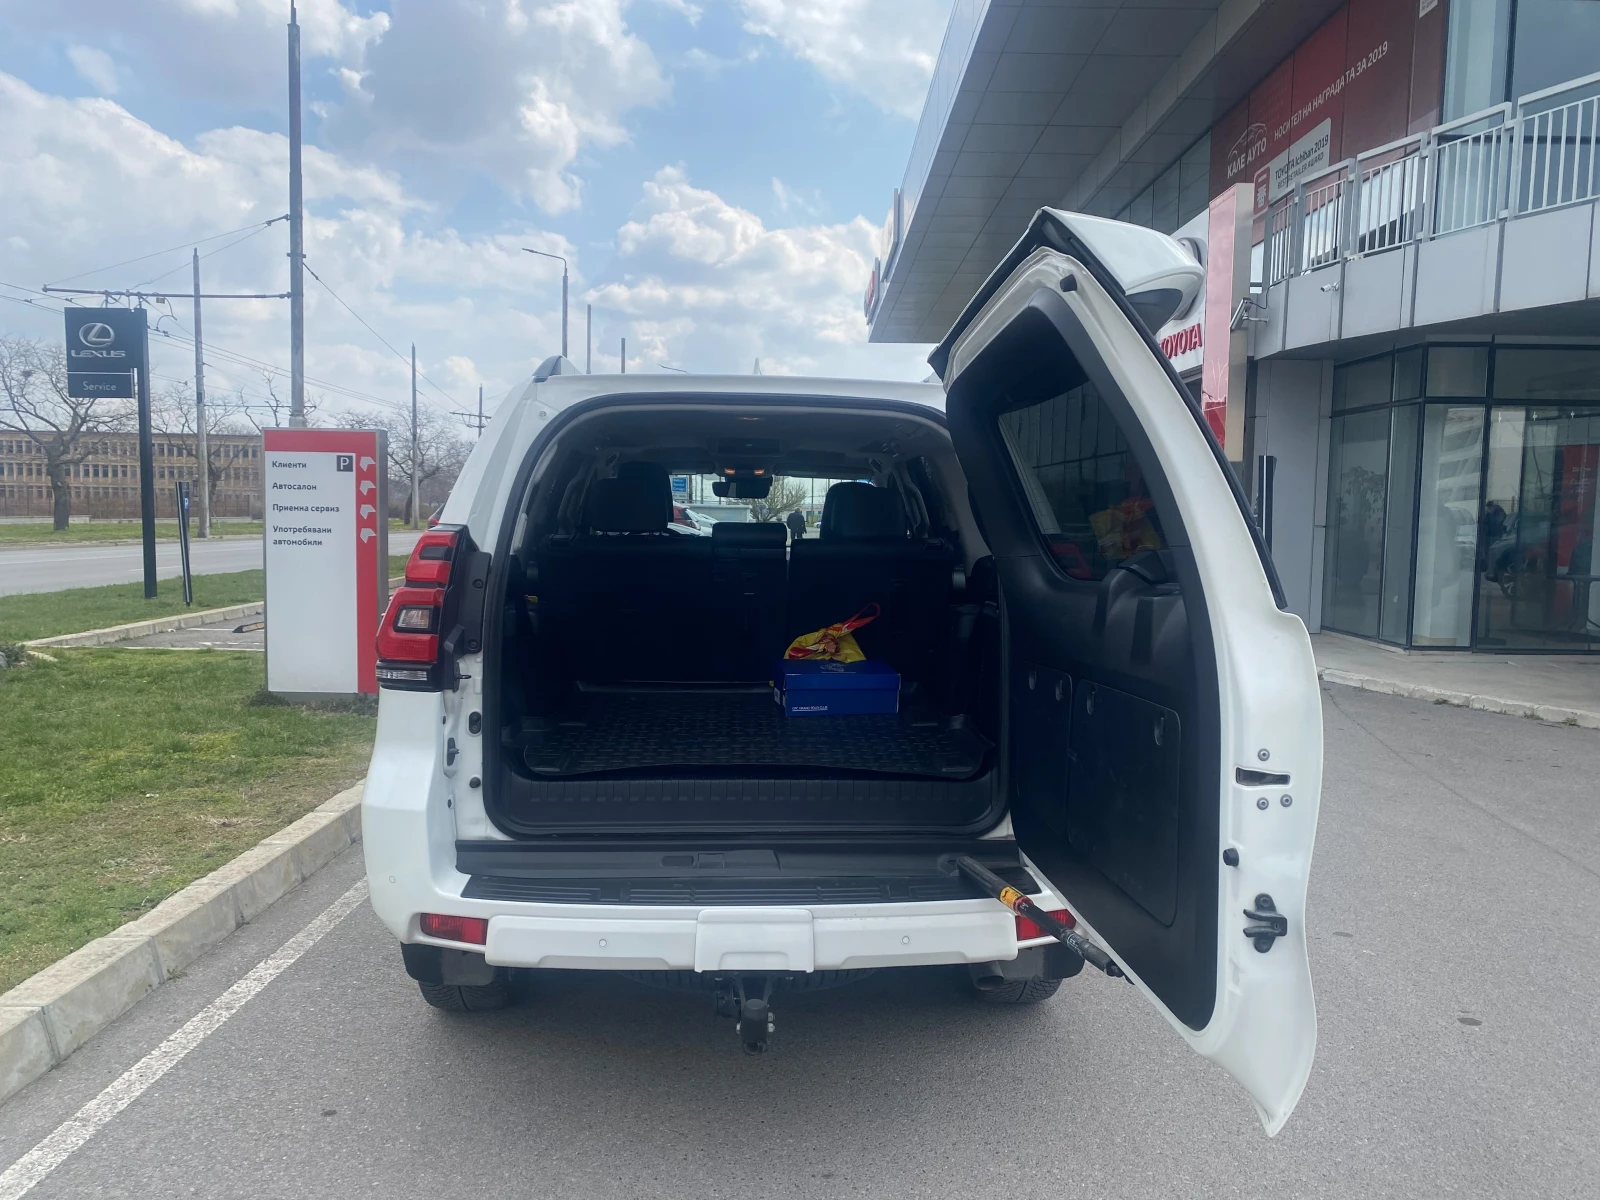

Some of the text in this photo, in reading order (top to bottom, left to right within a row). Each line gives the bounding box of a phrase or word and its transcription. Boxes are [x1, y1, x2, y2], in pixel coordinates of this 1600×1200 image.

[1274, 109, 1302, 141] НОСИТЕЛ
[1302, 102, 1312, 119] НА
[1367, 40, 1388, 68] 2019
[1275, 159, 1295, 181] TOYOTA
[1313, 134, 1329, 153] 2019
[71, 349, 126, 358] LEXUS
[82, 380, 117, 391] Service
[272, 460, 307, 469] Клиенти
[272, 482, 317, 490] Автосалон
[272, 503, 340, 513] Приемна сервиз
[272, 525, 332, 534] Употребявани
[273, 538, 323, 546] автомобили
